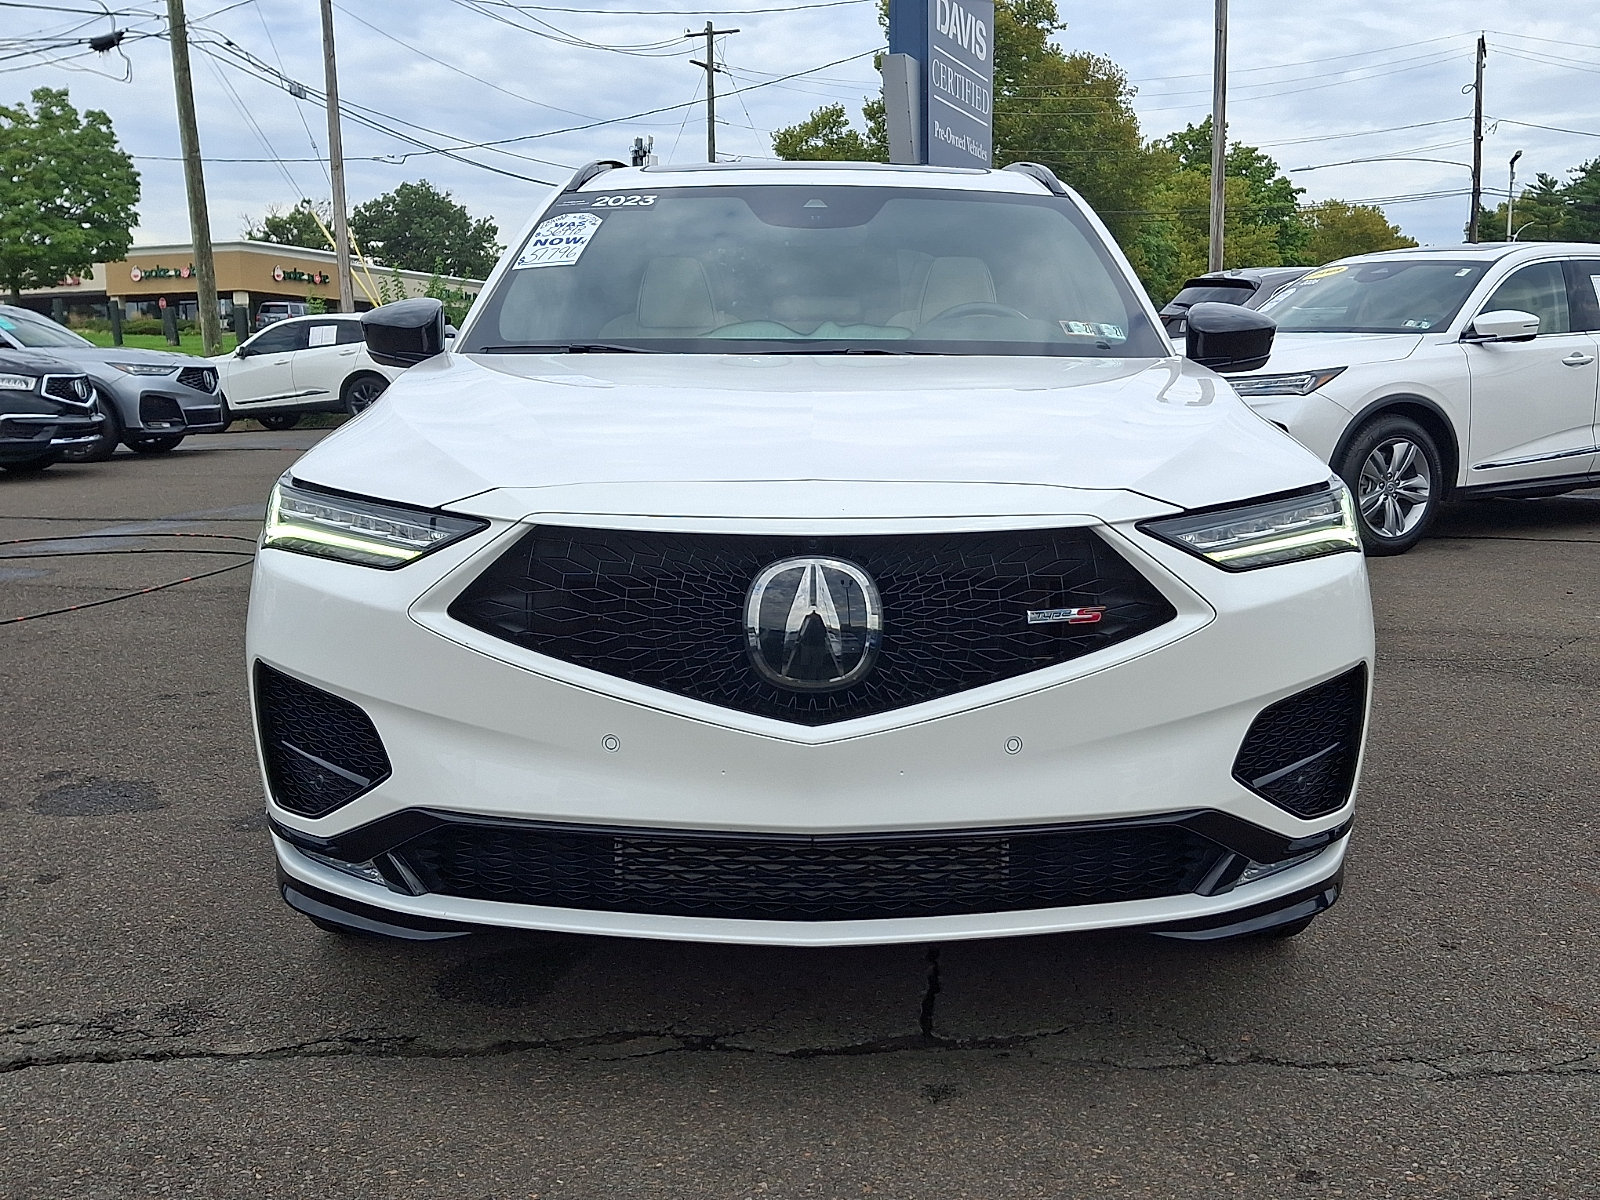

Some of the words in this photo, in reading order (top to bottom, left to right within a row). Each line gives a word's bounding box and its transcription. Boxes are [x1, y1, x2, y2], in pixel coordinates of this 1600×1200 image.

[935, 0, 987, 61] DAVIS
[931, 58, 990, 115] CERTIFIED
[934, 120, 966, 151] Pre-Owned
[966, 135, 988, 161] Vehicles
[591, 195, 657, 207] 2023
[554, 220, 587, 228] WAS
[533, 236, 584, 247] NOW
[1068, 606, 1106, 624] S
